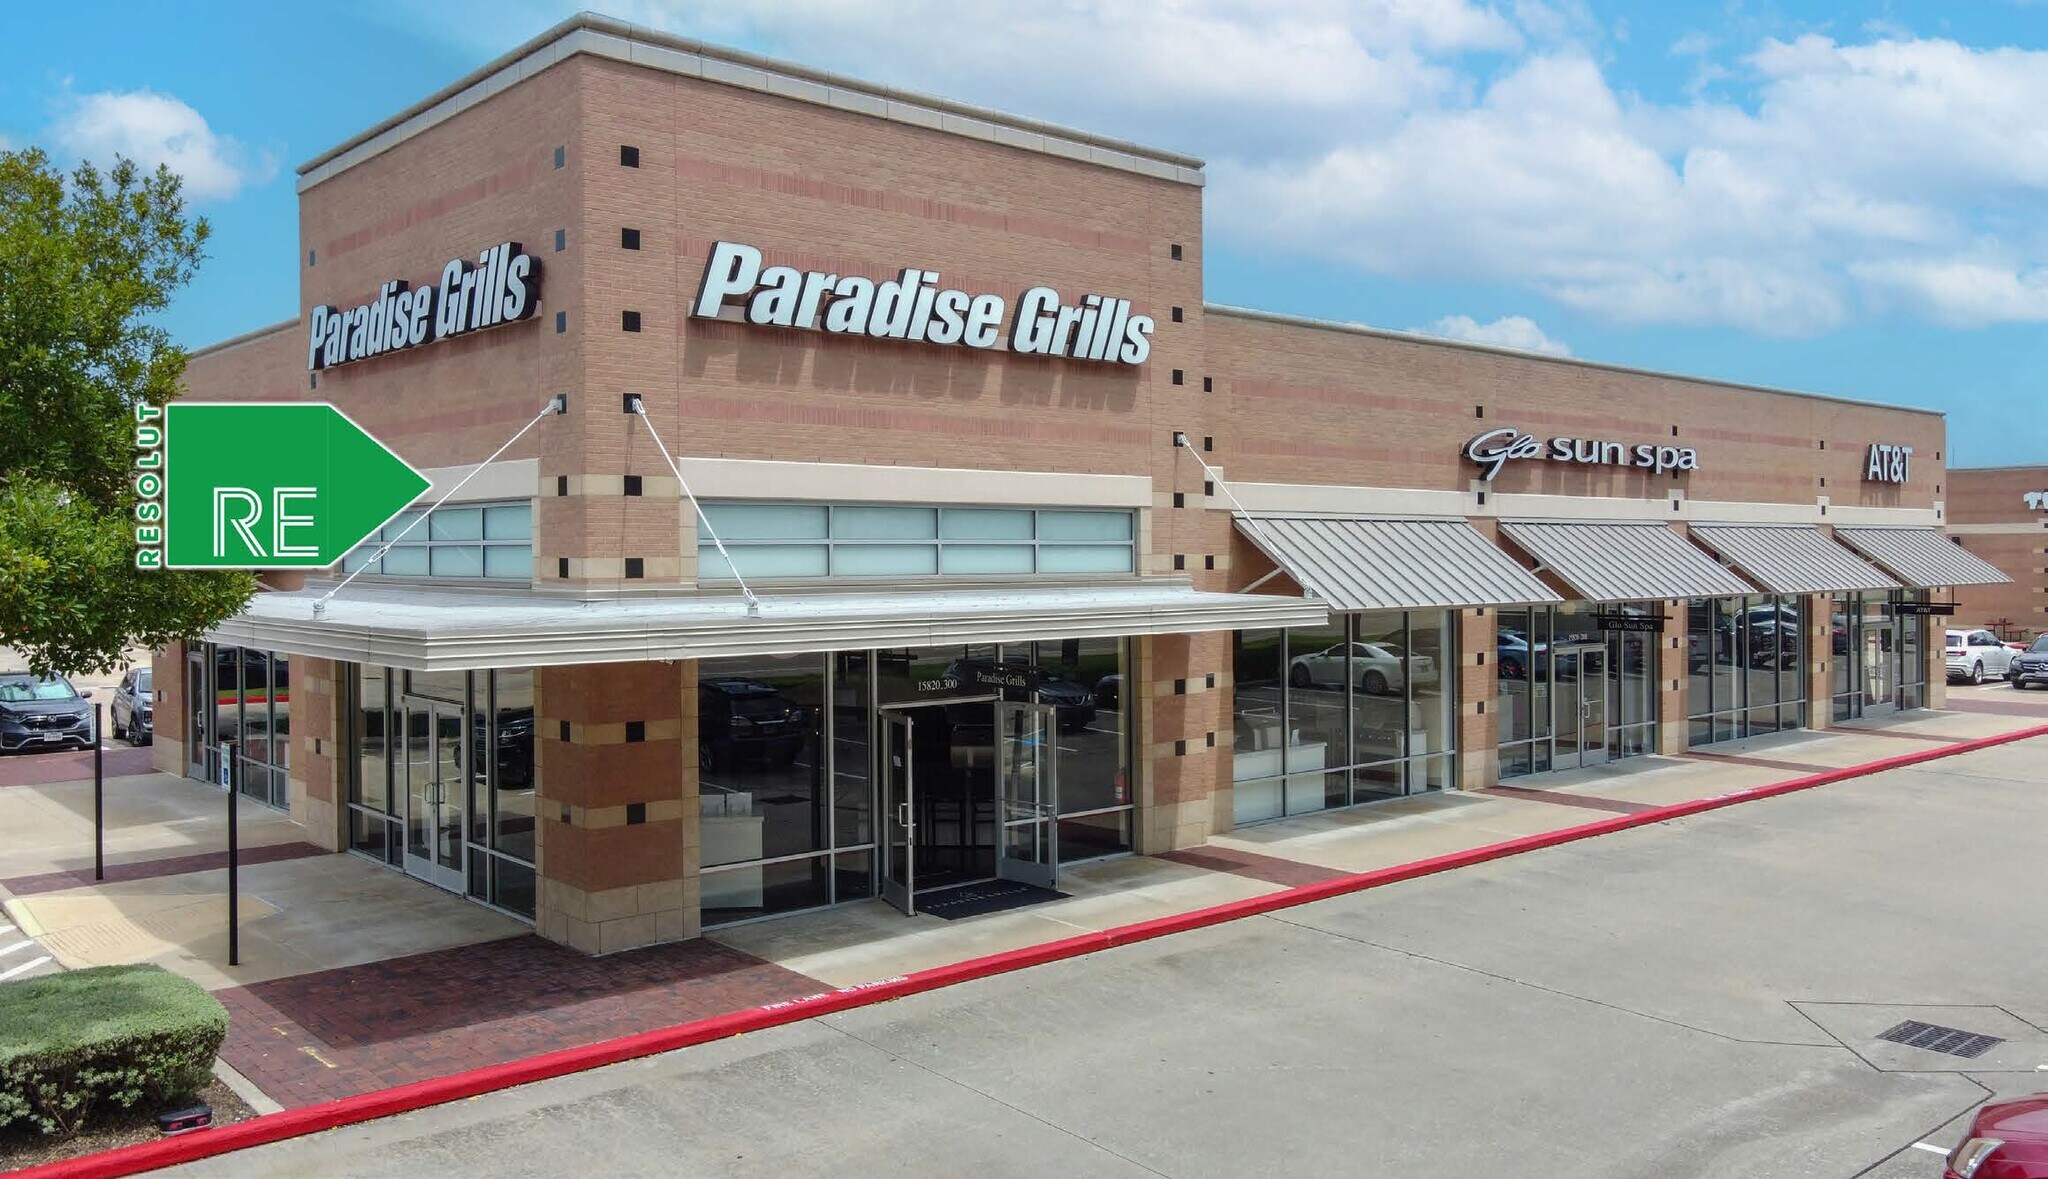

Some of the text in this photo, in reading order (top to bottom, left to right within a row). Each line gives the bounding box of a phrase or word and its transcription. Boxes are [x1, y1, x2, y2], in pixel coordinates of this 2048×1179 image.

[308, 242, 536, 371] Paradise Grills
[696, 241, 1156, 366] Paradise Grills
[1466, 428, 1698, 481] Glo sun spa
[1868, 443, 1913, 482] AT&T
[1608, 621, 1653, 631] Glo Sun Spa
[976, 671, 1026, 687] Paradise Grills
